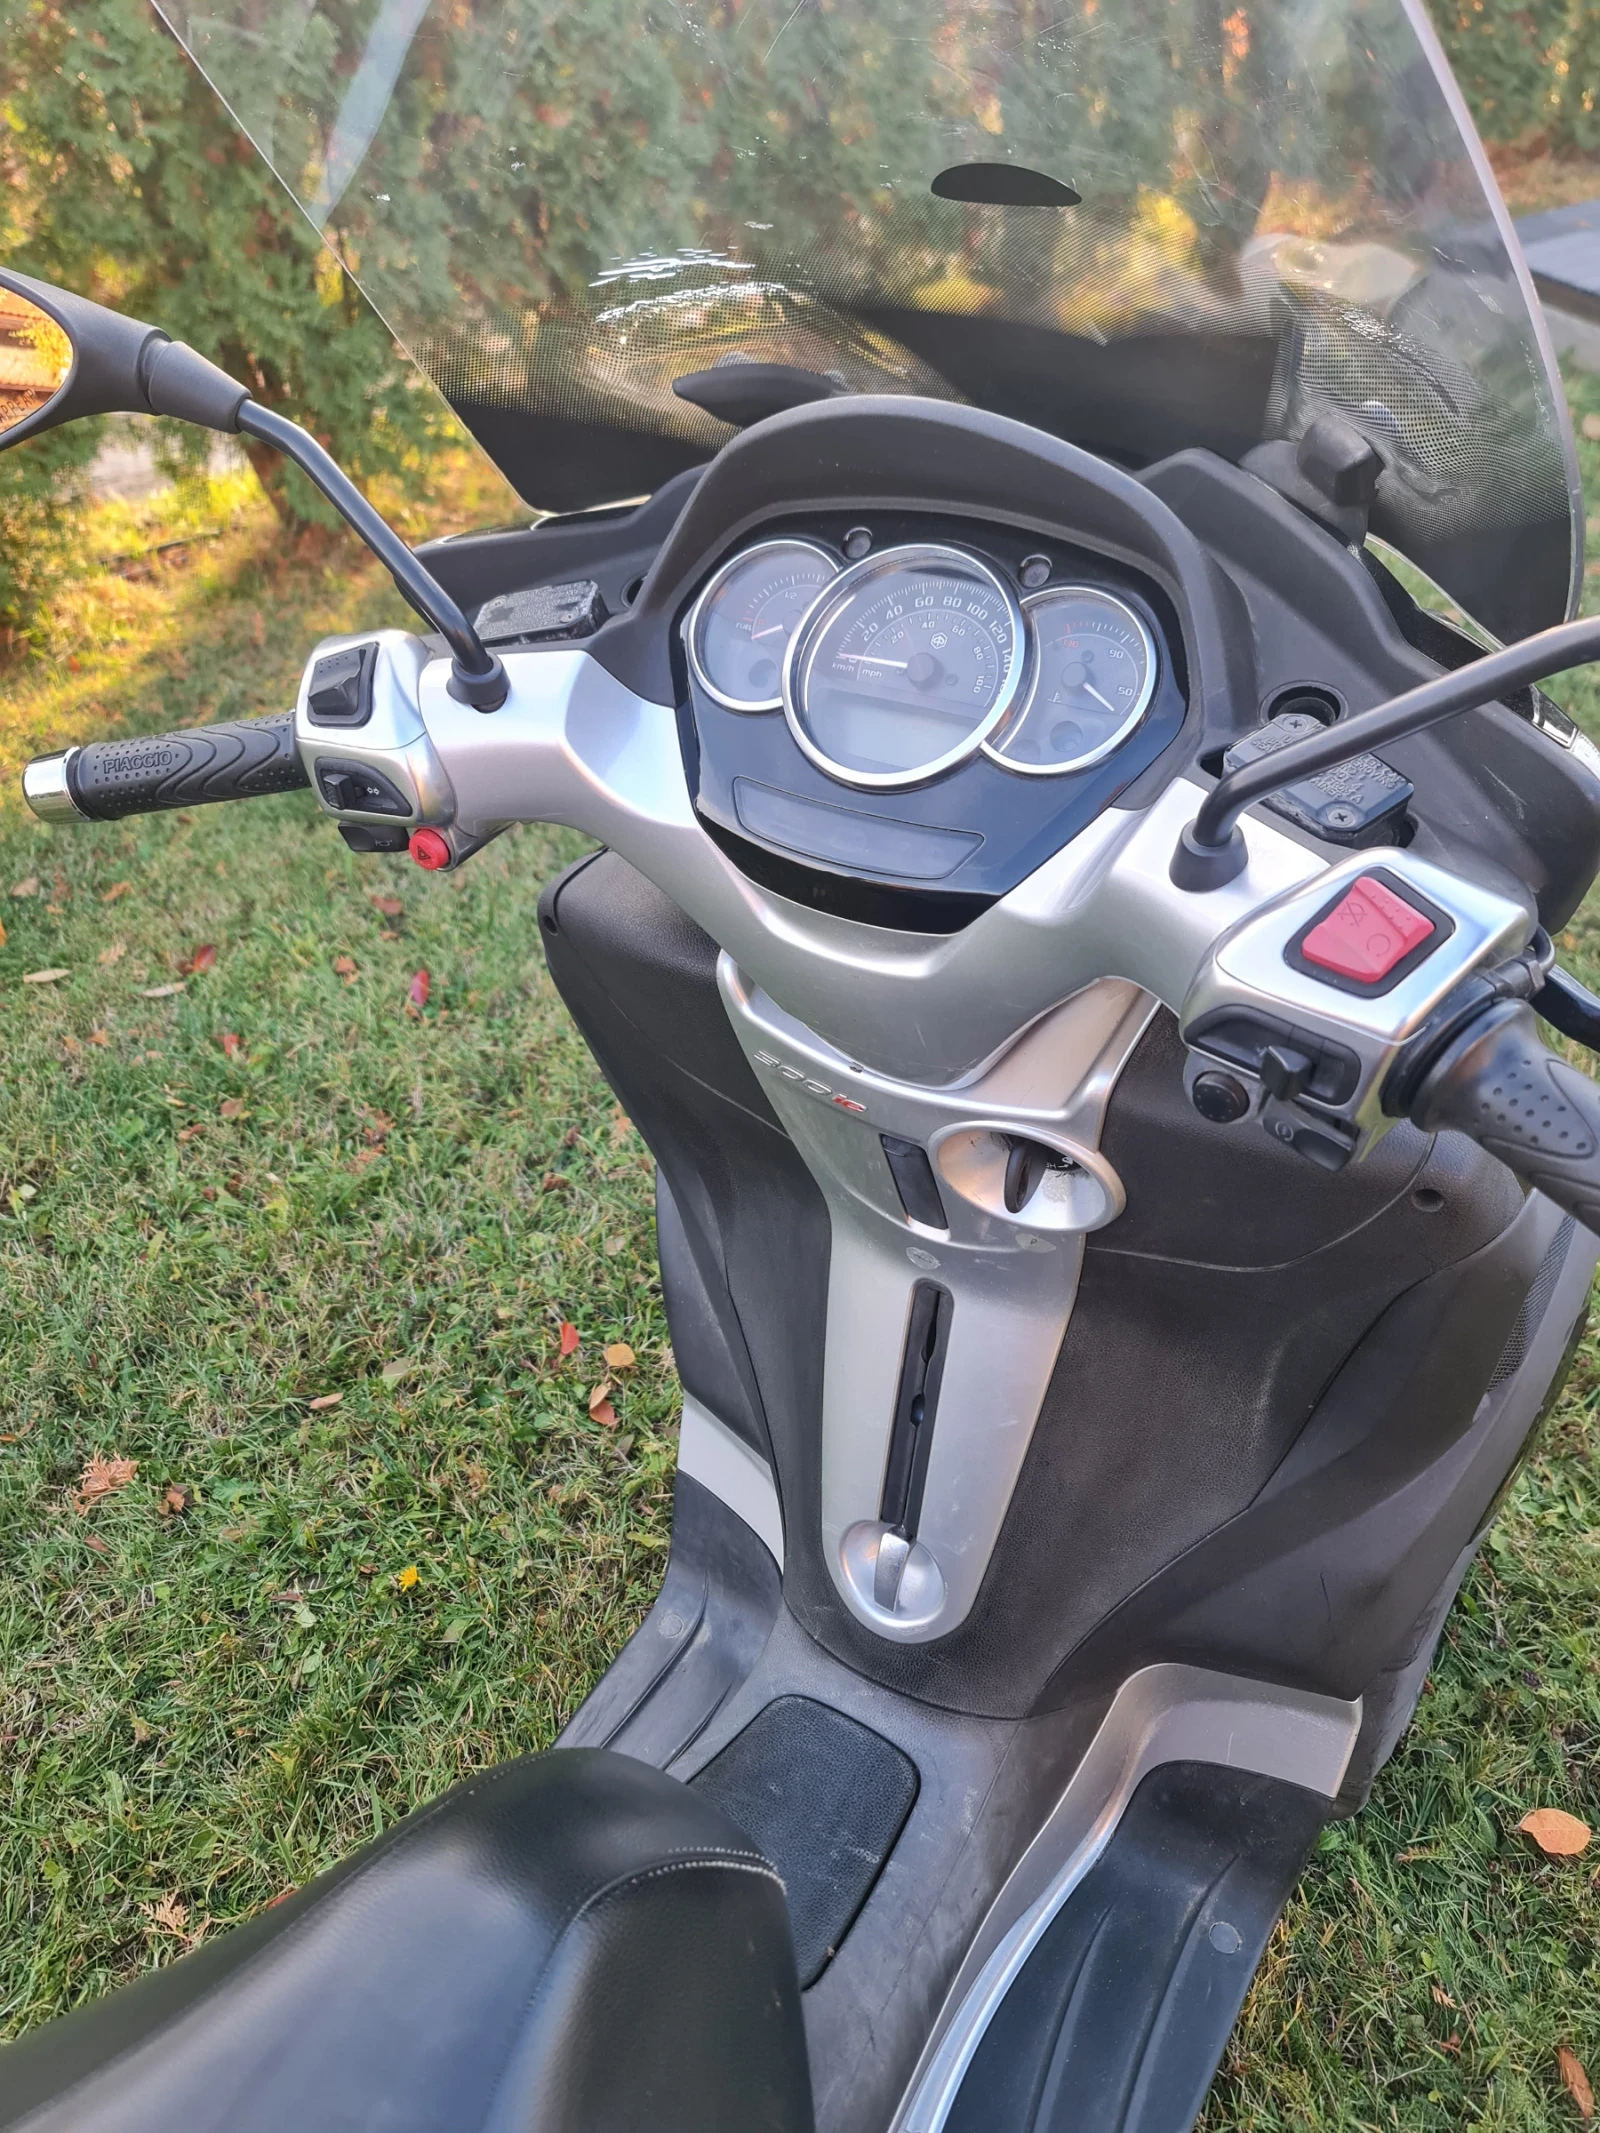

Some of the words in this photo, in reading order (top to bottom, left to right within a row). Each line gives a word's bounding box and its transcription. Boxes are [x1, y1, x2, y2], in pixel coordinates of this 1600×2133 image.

[785, 591, 798, 600] 1/2
[915, 597, 934, 608] 60
[943, 596, 962, 608] 80
[885, 606, 903, 620] 40
[966, 602, 988, 621] 100
[736, 622, 752, 632] FUEL
[921, 621, 935, 630] 40
[952, 625, 966, 637] 60
[861, 622, 879, 642] 20
[892, 632, 905, 644] 20
[989, 620, 1007, 644] 120
[1062, 639, 1080, 649] 130
[973, 646, 984, 660] 80
[1109, 649, 1124, 659] 90
[832, 661, 855, 672] km/h
[861, 668, 882, 678] mph
[973, 675, 985, 694] 100
[1117, 686, 1133, 697] 50
[103, 750, 172, 775] PIAGGIO
